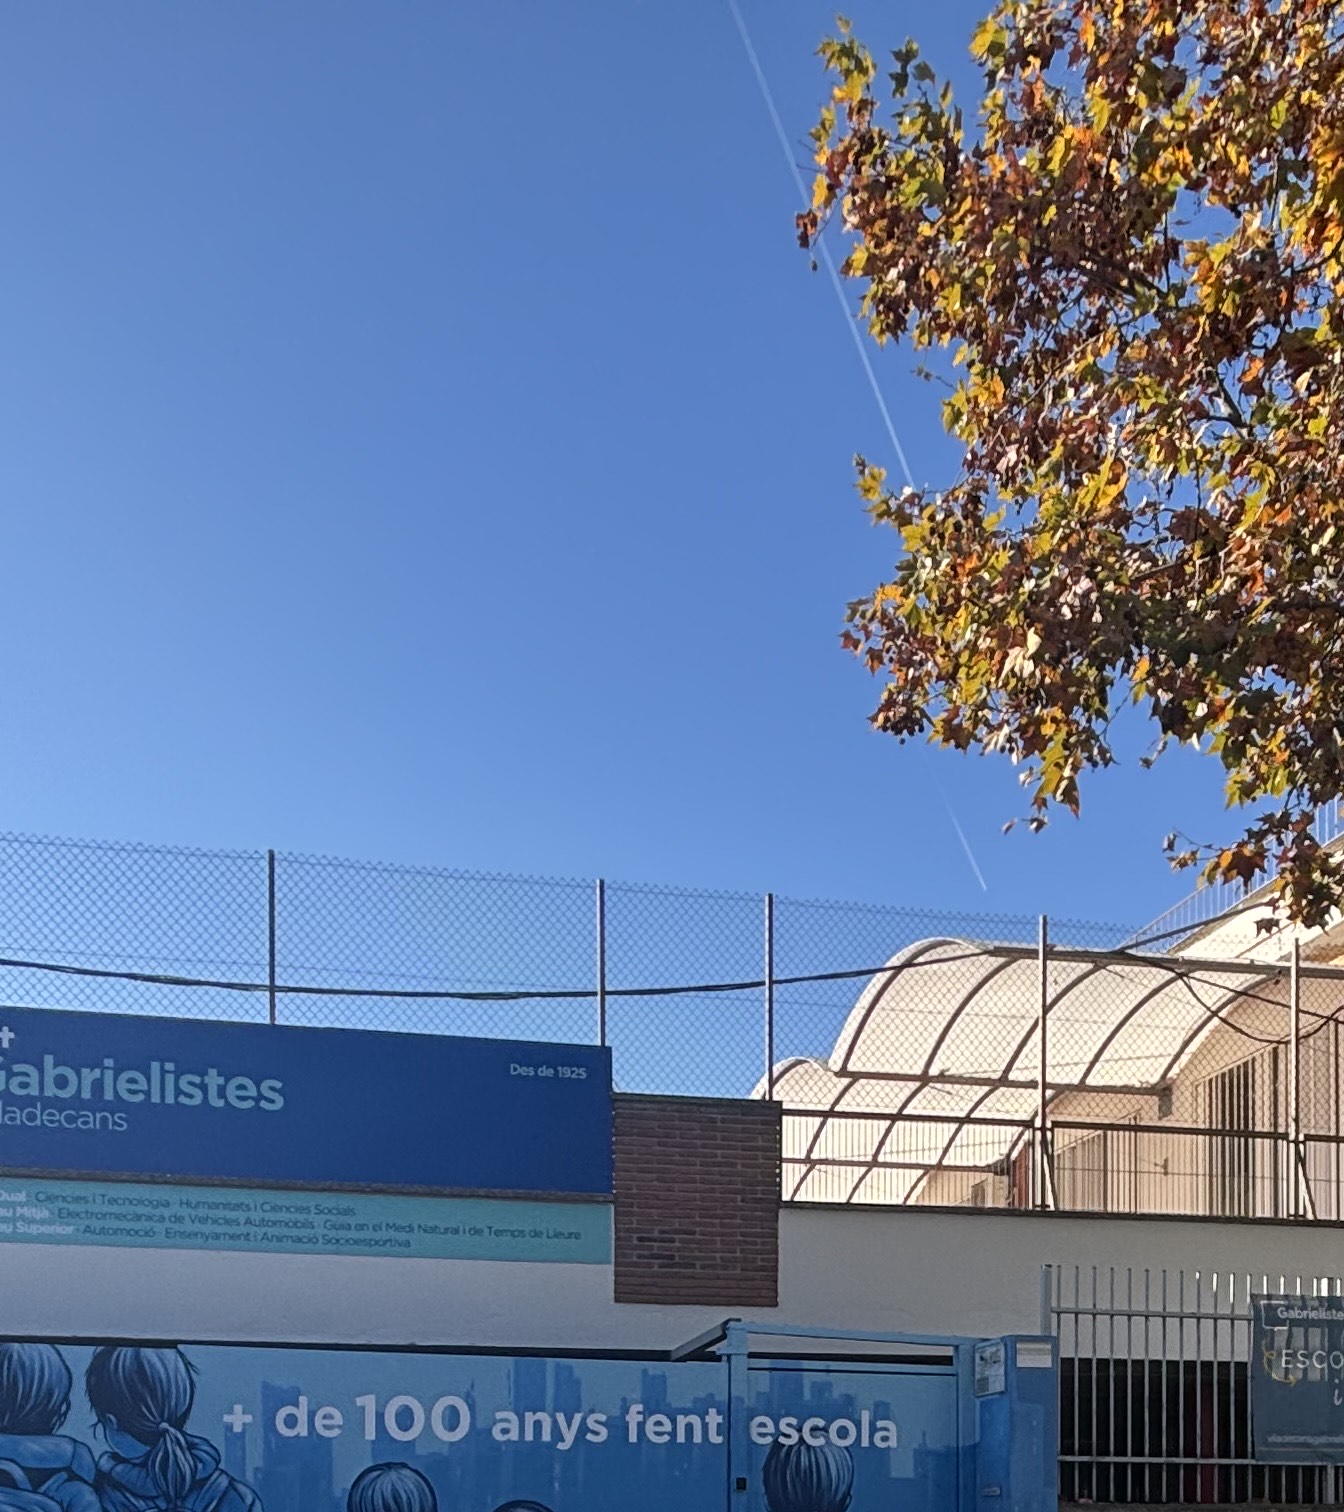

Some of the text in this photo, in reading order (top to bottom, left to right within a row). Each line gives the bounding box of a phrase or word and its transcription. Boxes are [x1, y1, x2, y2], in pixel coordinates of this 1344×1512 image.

[510, 1063, 587, 1079] Des de 1925
[97, 1193, 170, 1210] Tecnologia
[179, 1199, 252, 1214] Humanitats
[314, 1204, 356, 1217] Socials
[15, 1219, 74, 1236] Superior
[83, 1224, 156, 1239] Automoció
[165, 1227, 251, 1243] Ensenyament
[260, 1230, 319, 1245] Animació
[321, 1233, 411, 1249] Socioesportiva
[16, 1205, 49, 1221] Mitjà
[168, 1211, 186, 1225] de
[188, 1212, 240, 1227] Vehicles
[323, 1219, 352, 1232] Guia
[354, 1222, 370, 1232] en
[372, 1221, 384, 1233] el
[386, 1221, 415, 1234] Medi
[418, 1223, 460, 1236] Natural
[468, 1225, 485, 1238] de
[487, 1226, 526, 1240] Temps
[528, 1227, 544, 1239] de
[546, 1228, 582, 1241] Lleure
[1333, 1379, 1343, 1406] i
[274, 1395, 344, 1438] de
[355, 1393, 472, 1442] 100
[491, 1407, 610, 1451] anys
[625, 1403, 725, 1445] fent
[749, 1407, 899, 1450] escola
